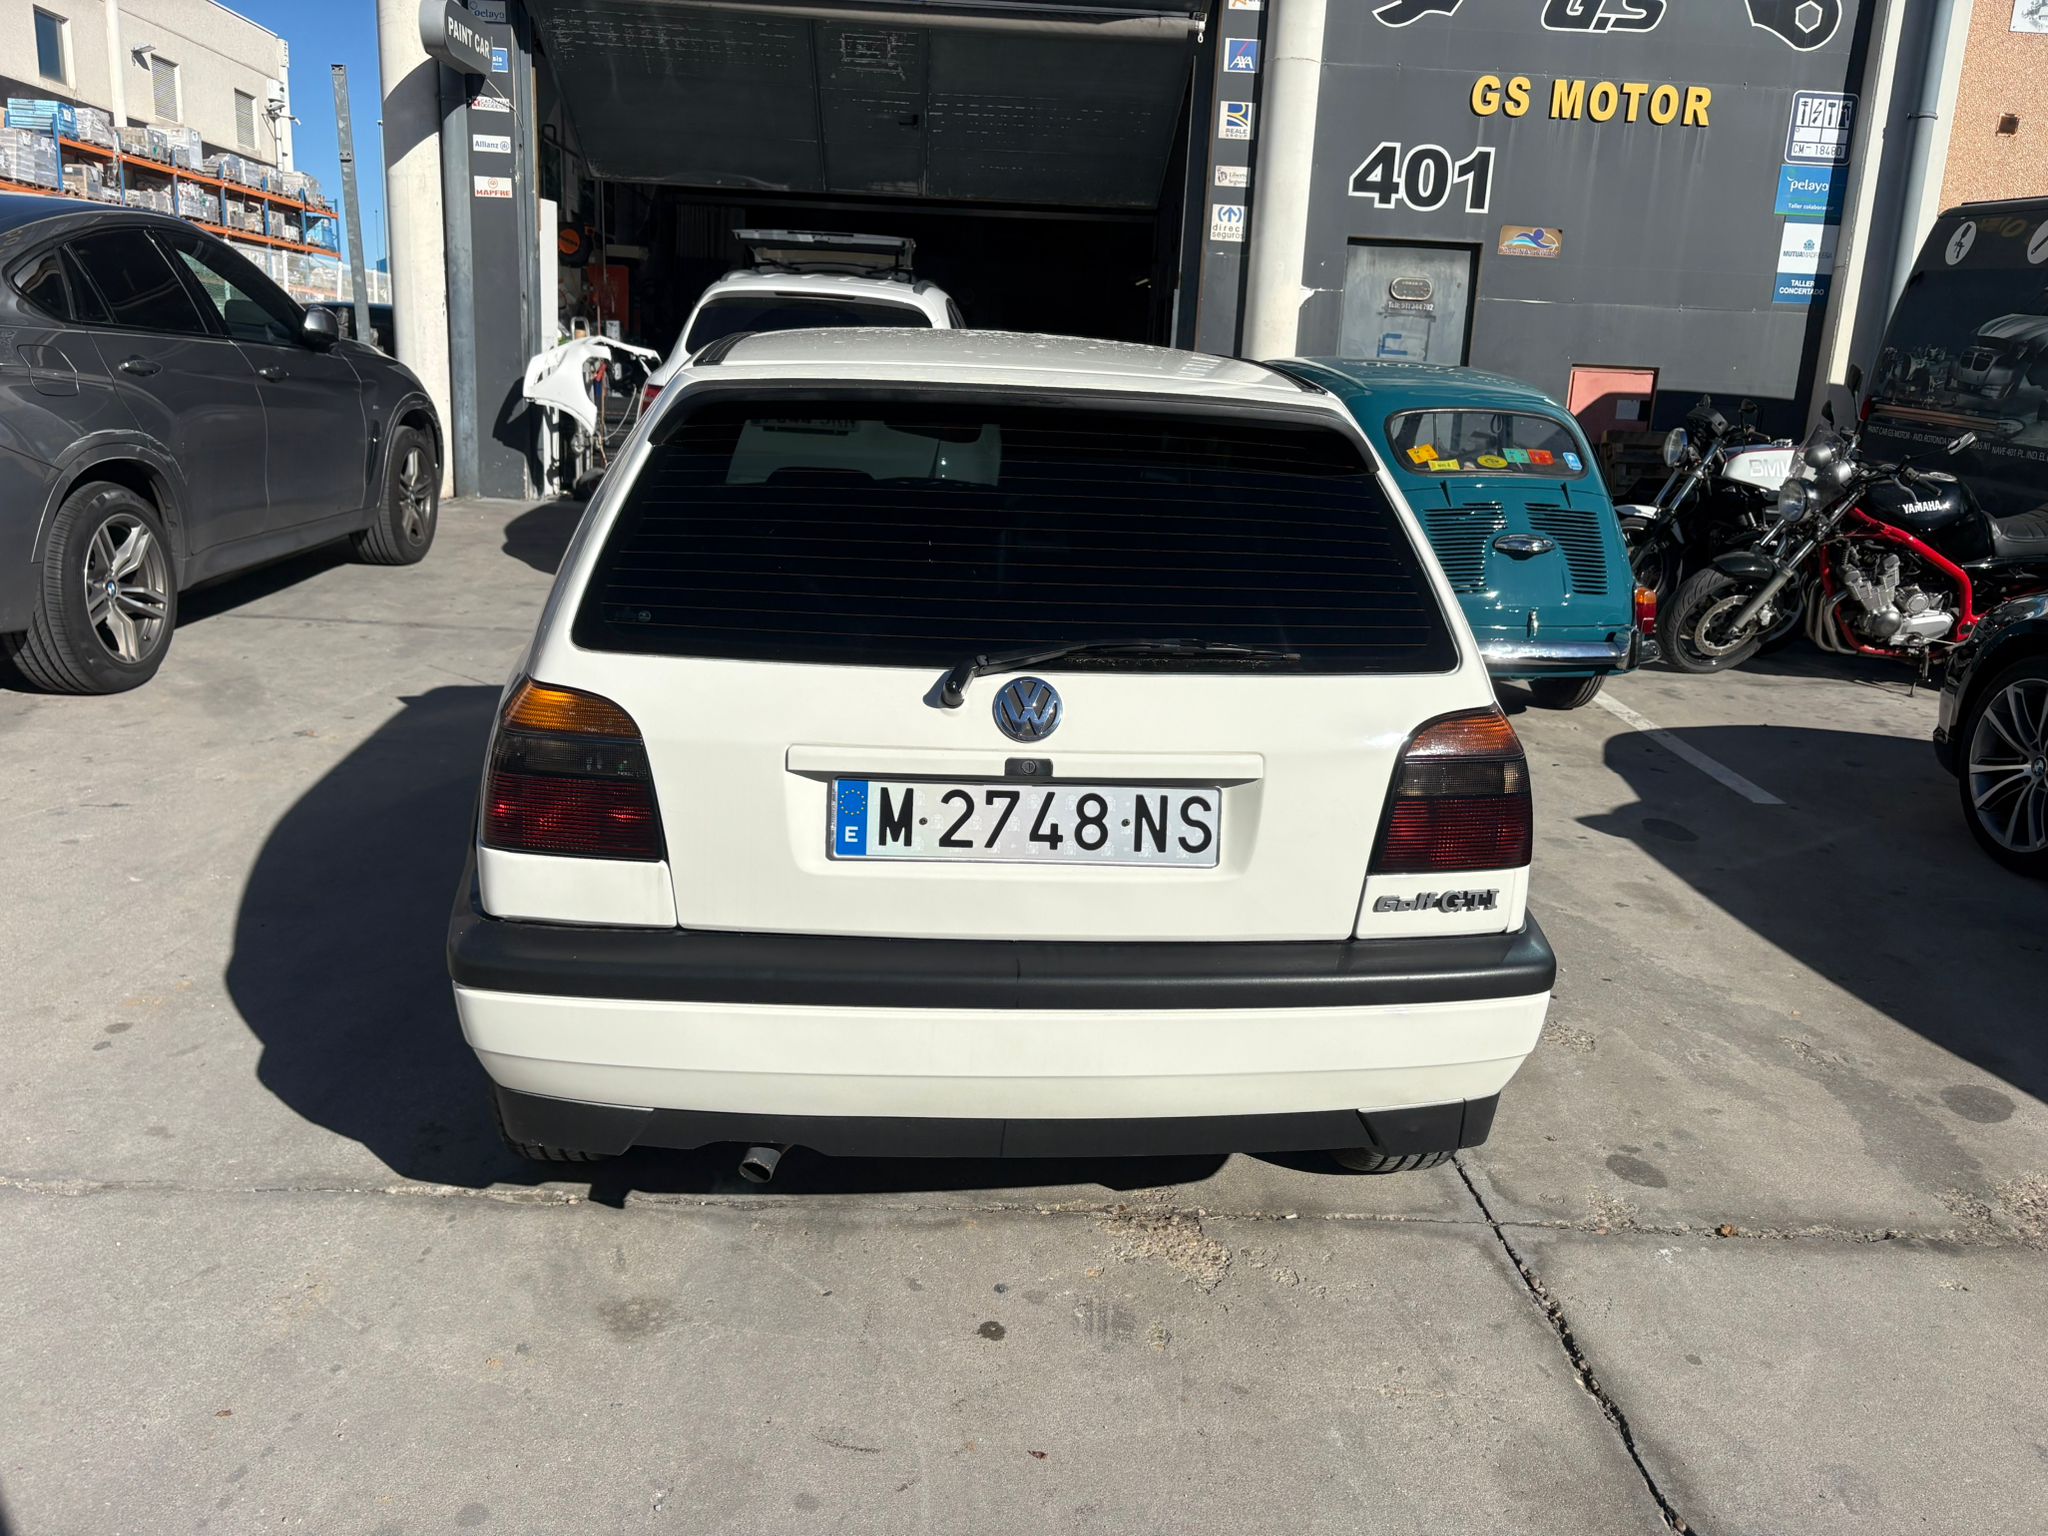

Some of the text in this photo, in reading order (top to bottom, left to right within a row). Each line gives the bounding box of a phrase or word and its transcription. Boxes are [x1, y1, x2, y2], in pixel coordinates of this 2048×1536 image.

[447, 16, 490, 59] PAINT CAR
[1230, 56, 1254, 69] AXA
[1470, 76, 1713, 127] GS MOTOR
[474, 140, 499, 149] Allianz
[1348, 141, 1496, 214] 401
[1789, 178, 1829, 193] pelayo
[476, 189, 510, 197] MAPFRE
[1790, 279, 1815, 288] TALLER
[1779, 286, 1825, 296] CONCERTADO
[1902, 500, 1942, 514] YAMAHA
[844, 826, 858, 842] E
[1373, 889, 1500, 913] Golf GTI
